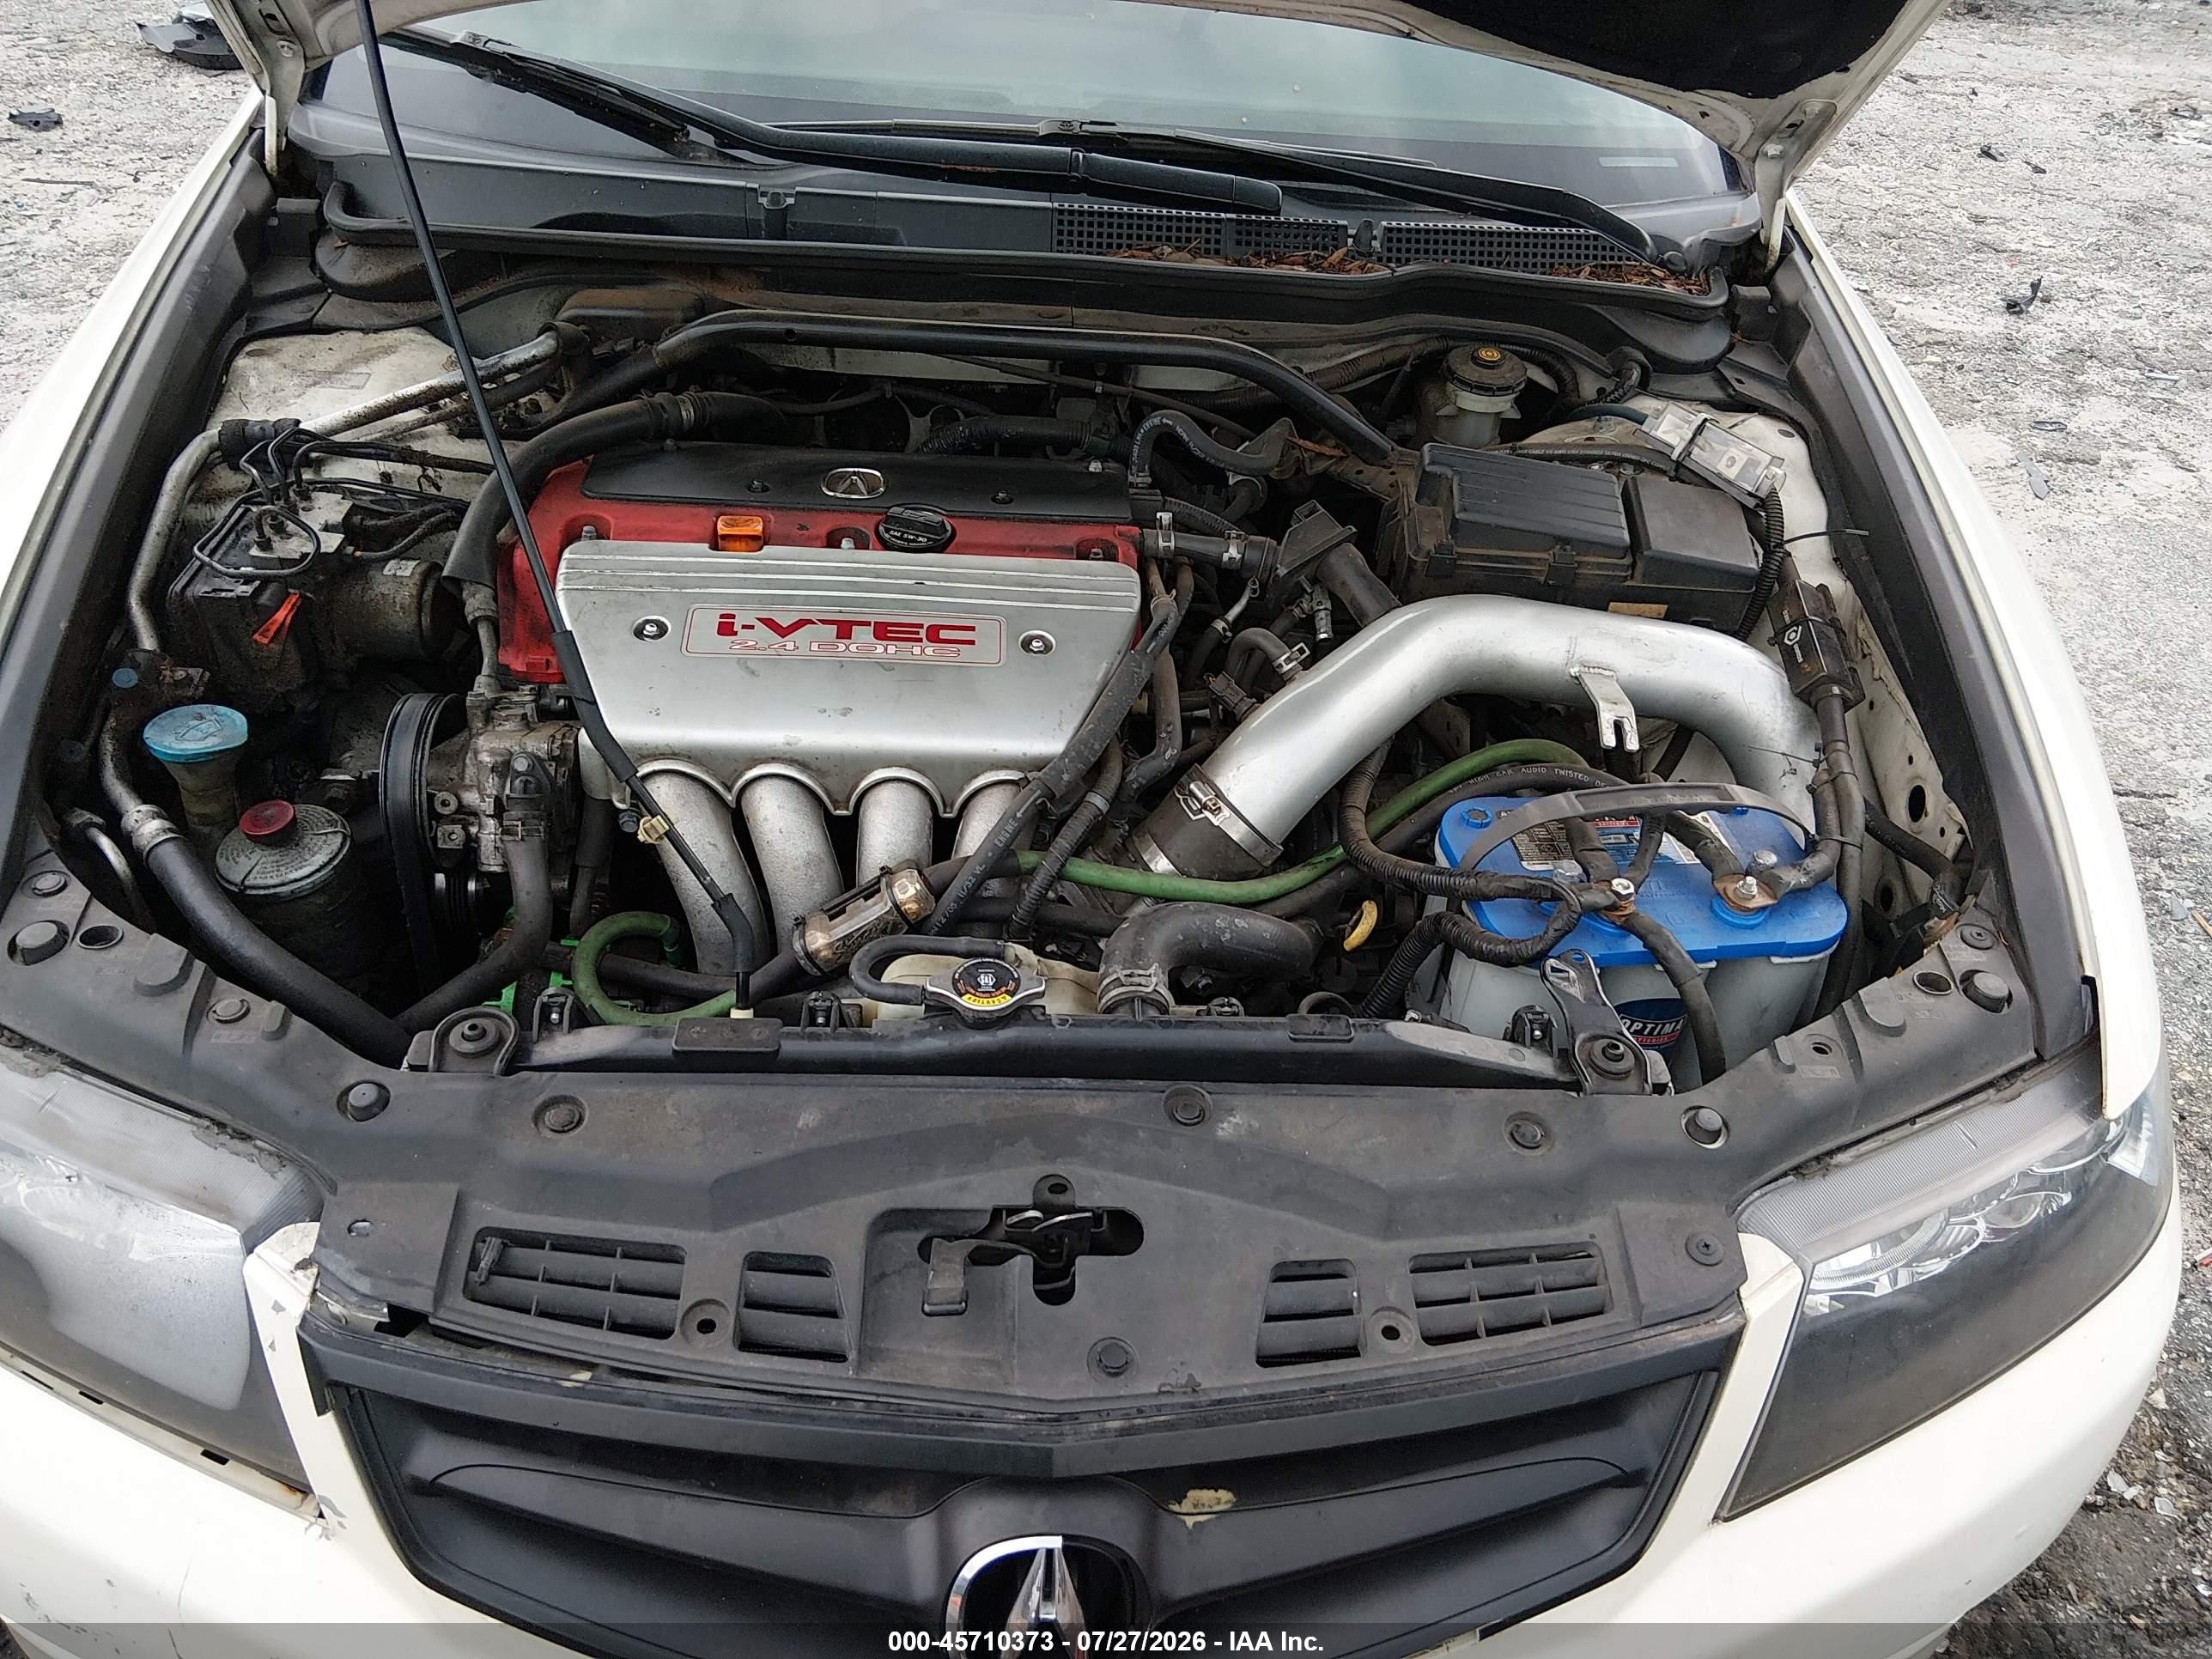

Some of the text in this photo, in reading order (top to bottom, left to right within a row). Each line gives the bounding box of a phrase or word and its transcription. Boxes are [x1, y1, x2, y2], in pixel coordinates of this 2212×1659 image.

[903, 532, 927, 543] 5W-30
[716, 612, 976, 646] i-VTEC
[729, 639, 961, 658] 2.4 DOHC
[1496, 769, 1513, 777] CAR
[1521, 764, 1547, 774] AUDIO
[1553, 768, 1590, 783] TWISTED
[994, 818, 1018, 848] ENGINE
[1621, 1018, 1684, 1036] OPTIMA
